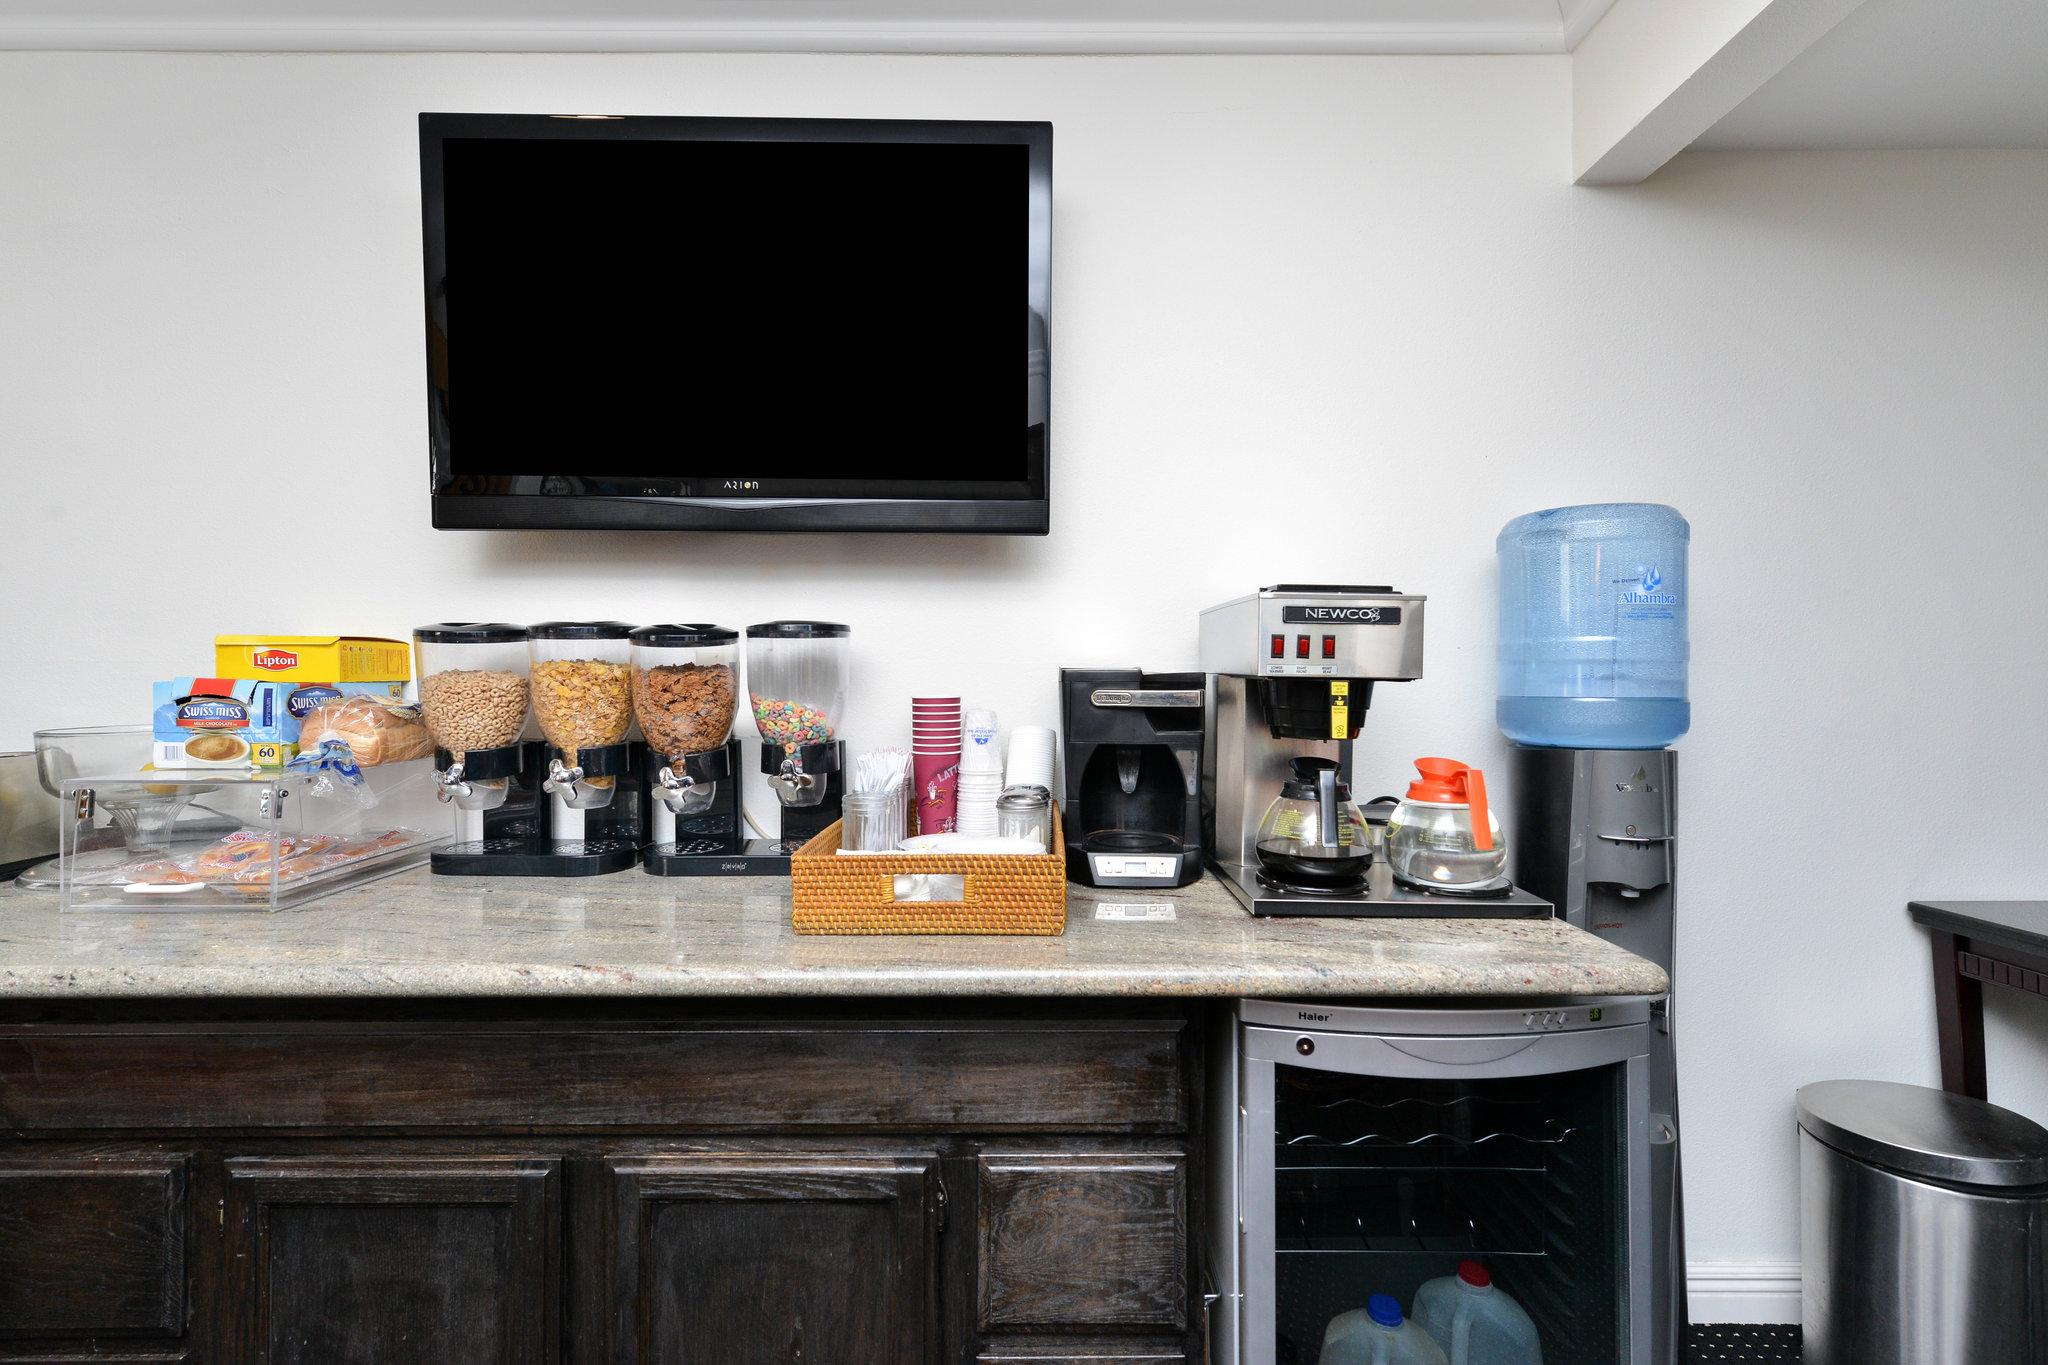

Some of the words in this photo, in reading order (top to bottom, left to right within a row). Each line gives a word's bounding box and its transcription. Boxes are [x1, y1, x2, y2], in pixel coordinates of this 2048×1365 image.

[723, 481, 759, 490] ARION
[1618, 592, 1676, 604] Alhambra
[1305, 608, 1372, 619] NEWCO
[257, 655, 295, 668] Lipton
[291, 697, 319, 711] SWISS
[183, 705, 214, 718] SWISS
[216, 706, 242, 719] MISS
[259, 747, 275, 758] 60
[937, 762, 960, 783] LATT
[1298, 1011, 1330, 1022] Haier
